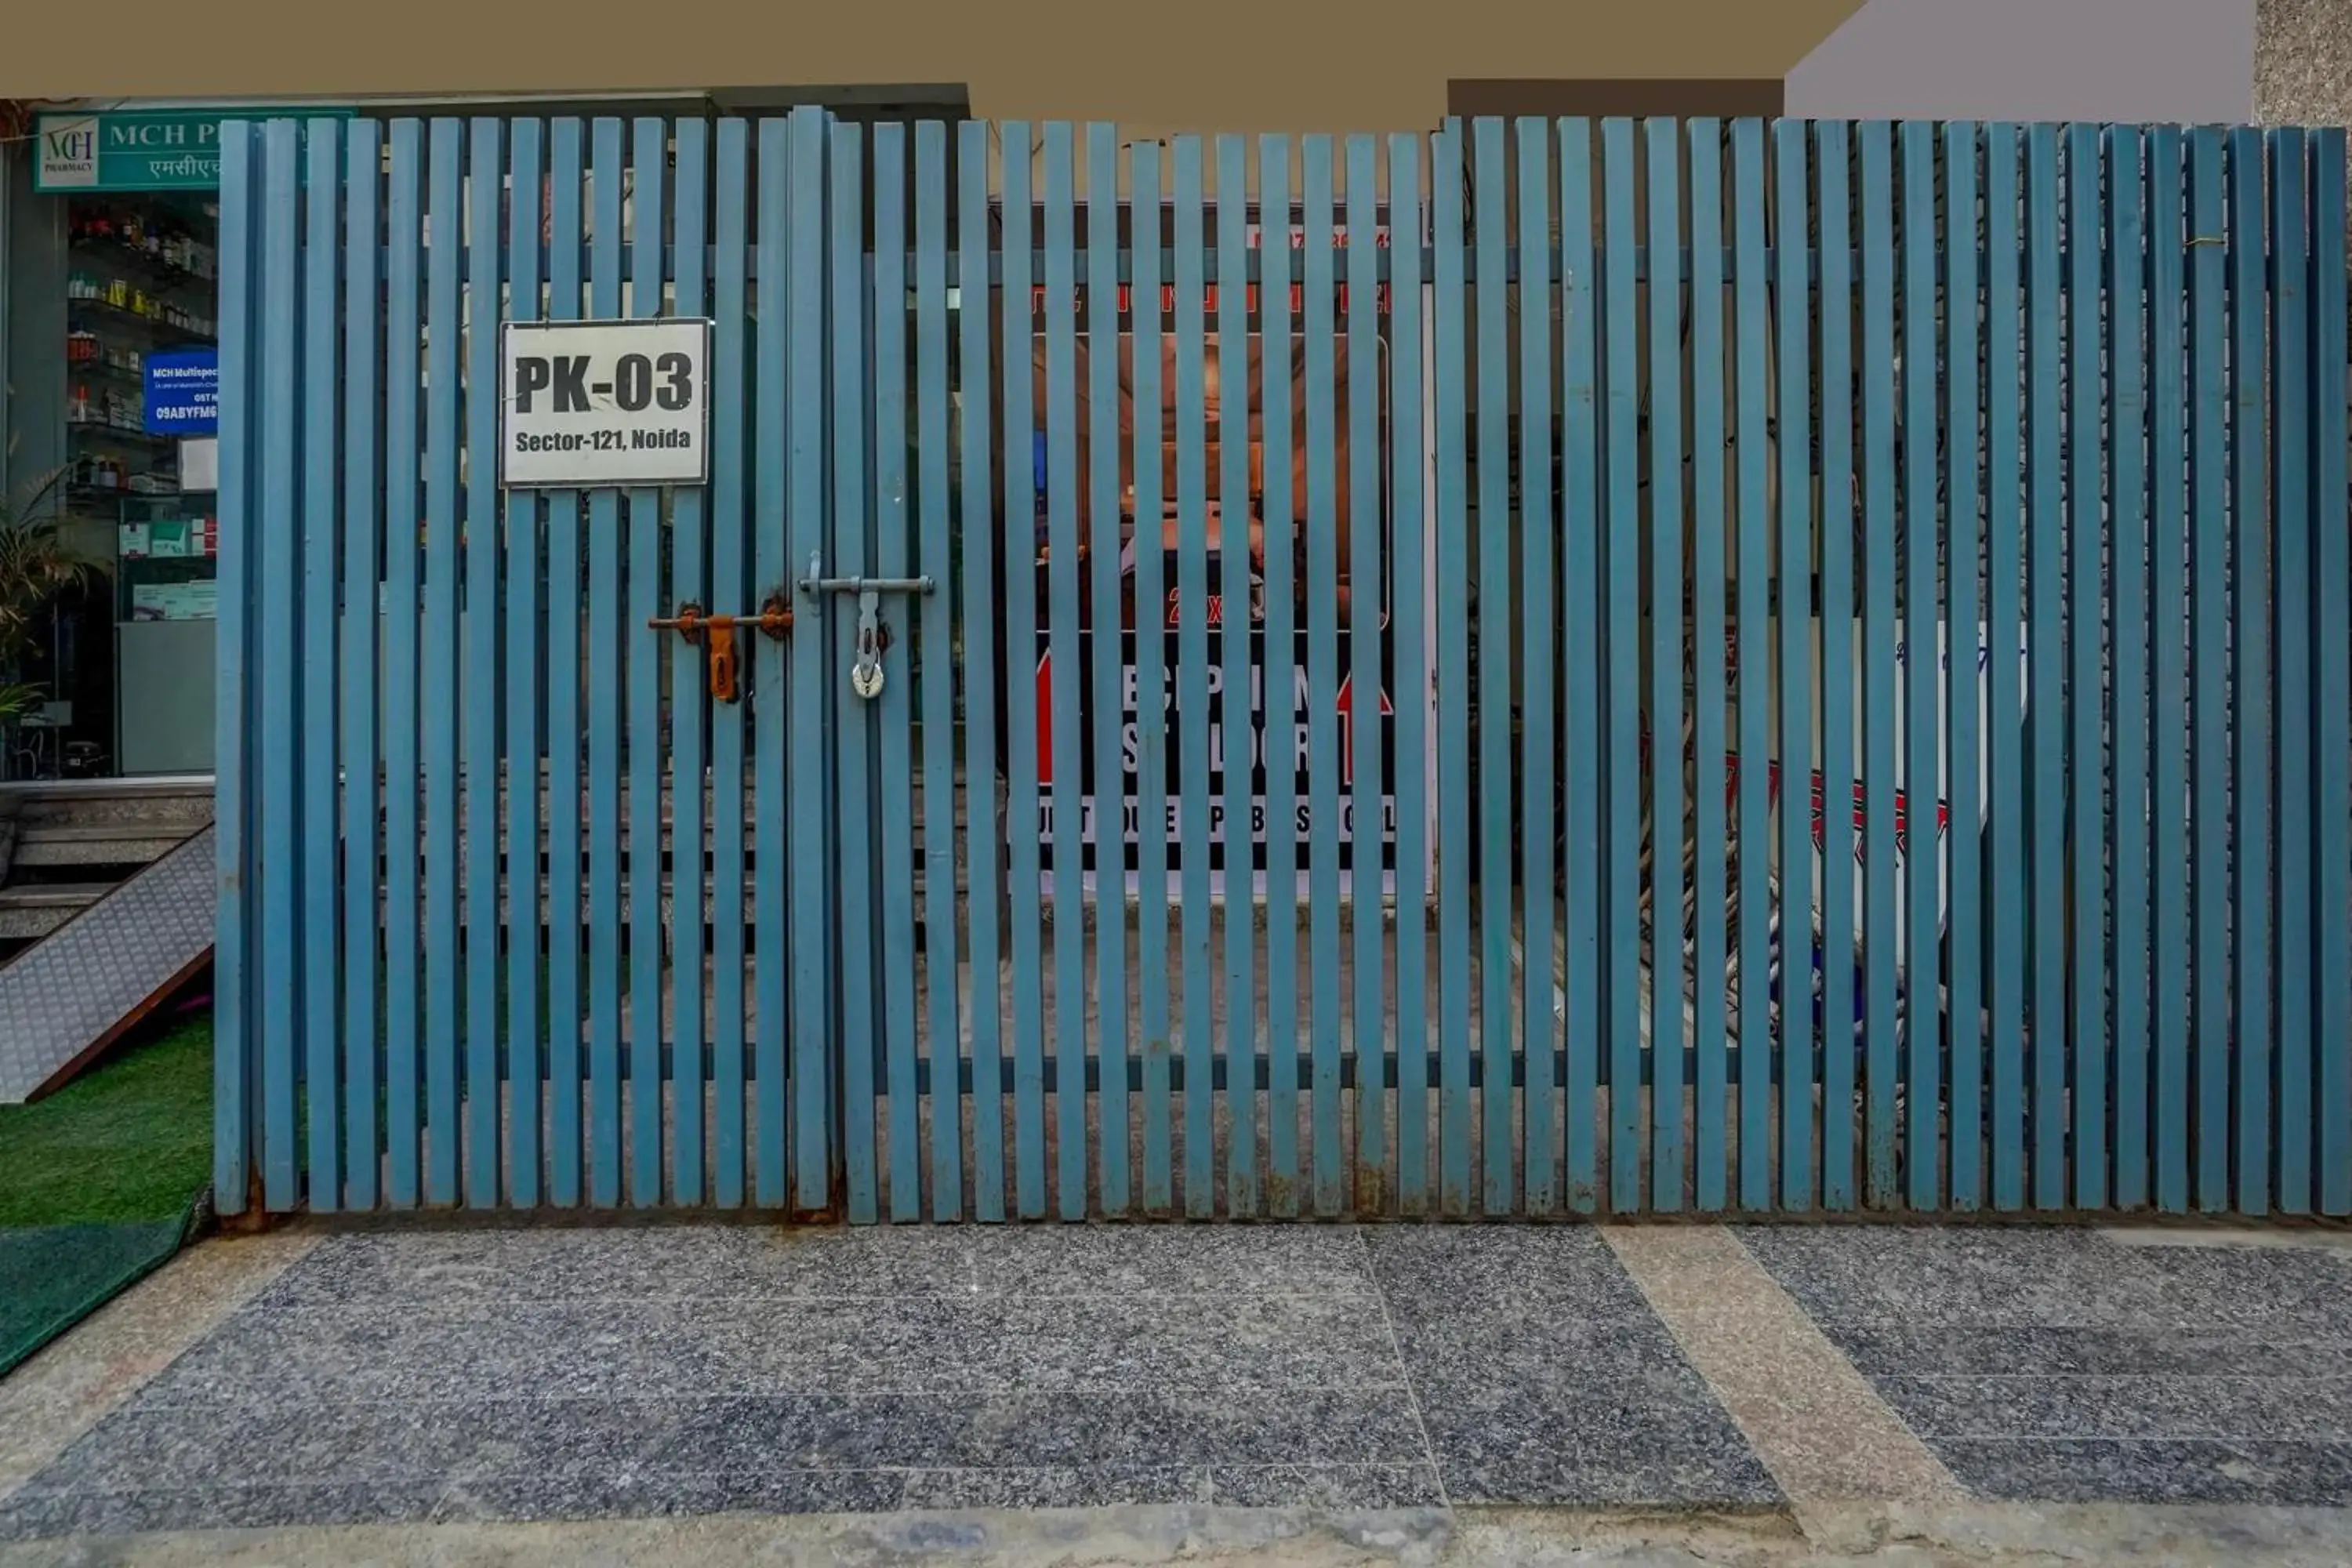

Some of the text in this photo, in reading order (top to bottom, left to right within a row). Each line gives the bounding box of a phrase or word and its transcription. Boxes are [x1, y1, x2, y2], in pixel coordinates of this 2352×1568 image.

[46, 131, 93, 160] MCH
[111, 124, 185, 146] MCH
[45, 162, 93, 173] PHARMACY
[153, 368, 173, 378] MCH
[515, 352, 693, 414] PK-03
[631, 429, 691, 449] Noida
